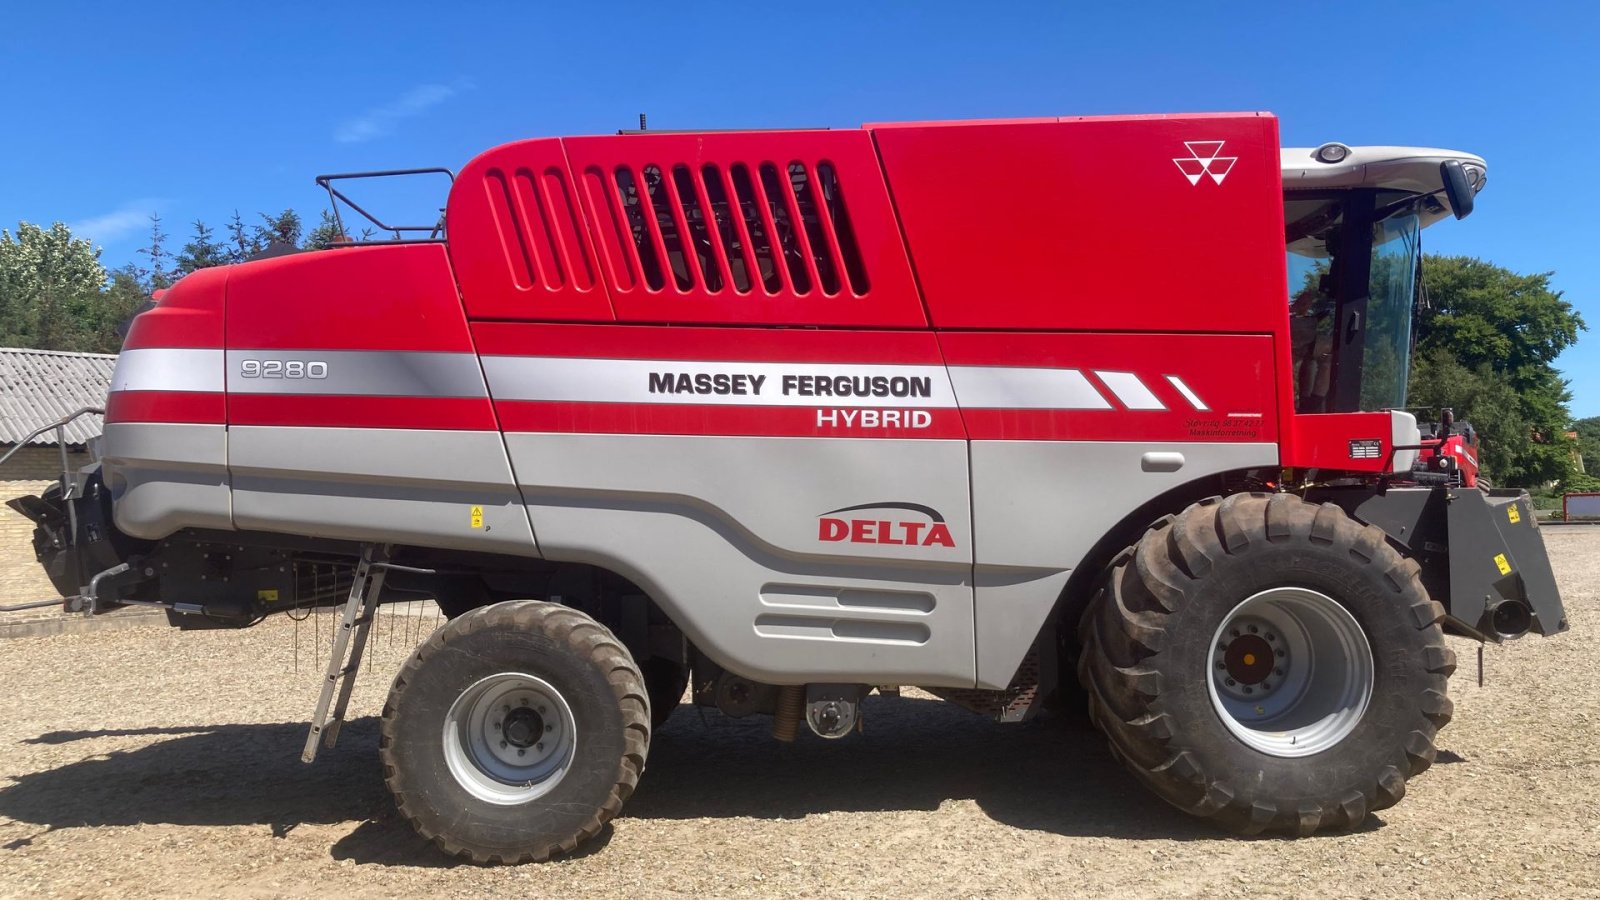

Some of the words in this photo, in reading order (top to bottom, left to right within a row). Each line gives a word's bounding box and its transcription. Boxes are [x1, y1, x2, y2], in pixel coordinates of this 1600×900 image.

[241, 360, 328, 379] 9280
[649, 372, 766, 396] MASSEY
[782, 375, 932, 398] FERGUSON
[816, 409, 932, 429] HYBRID
[1189, 429, 1257, 438] Maskinforretning
[819, 518, 956, 547] DELTA
